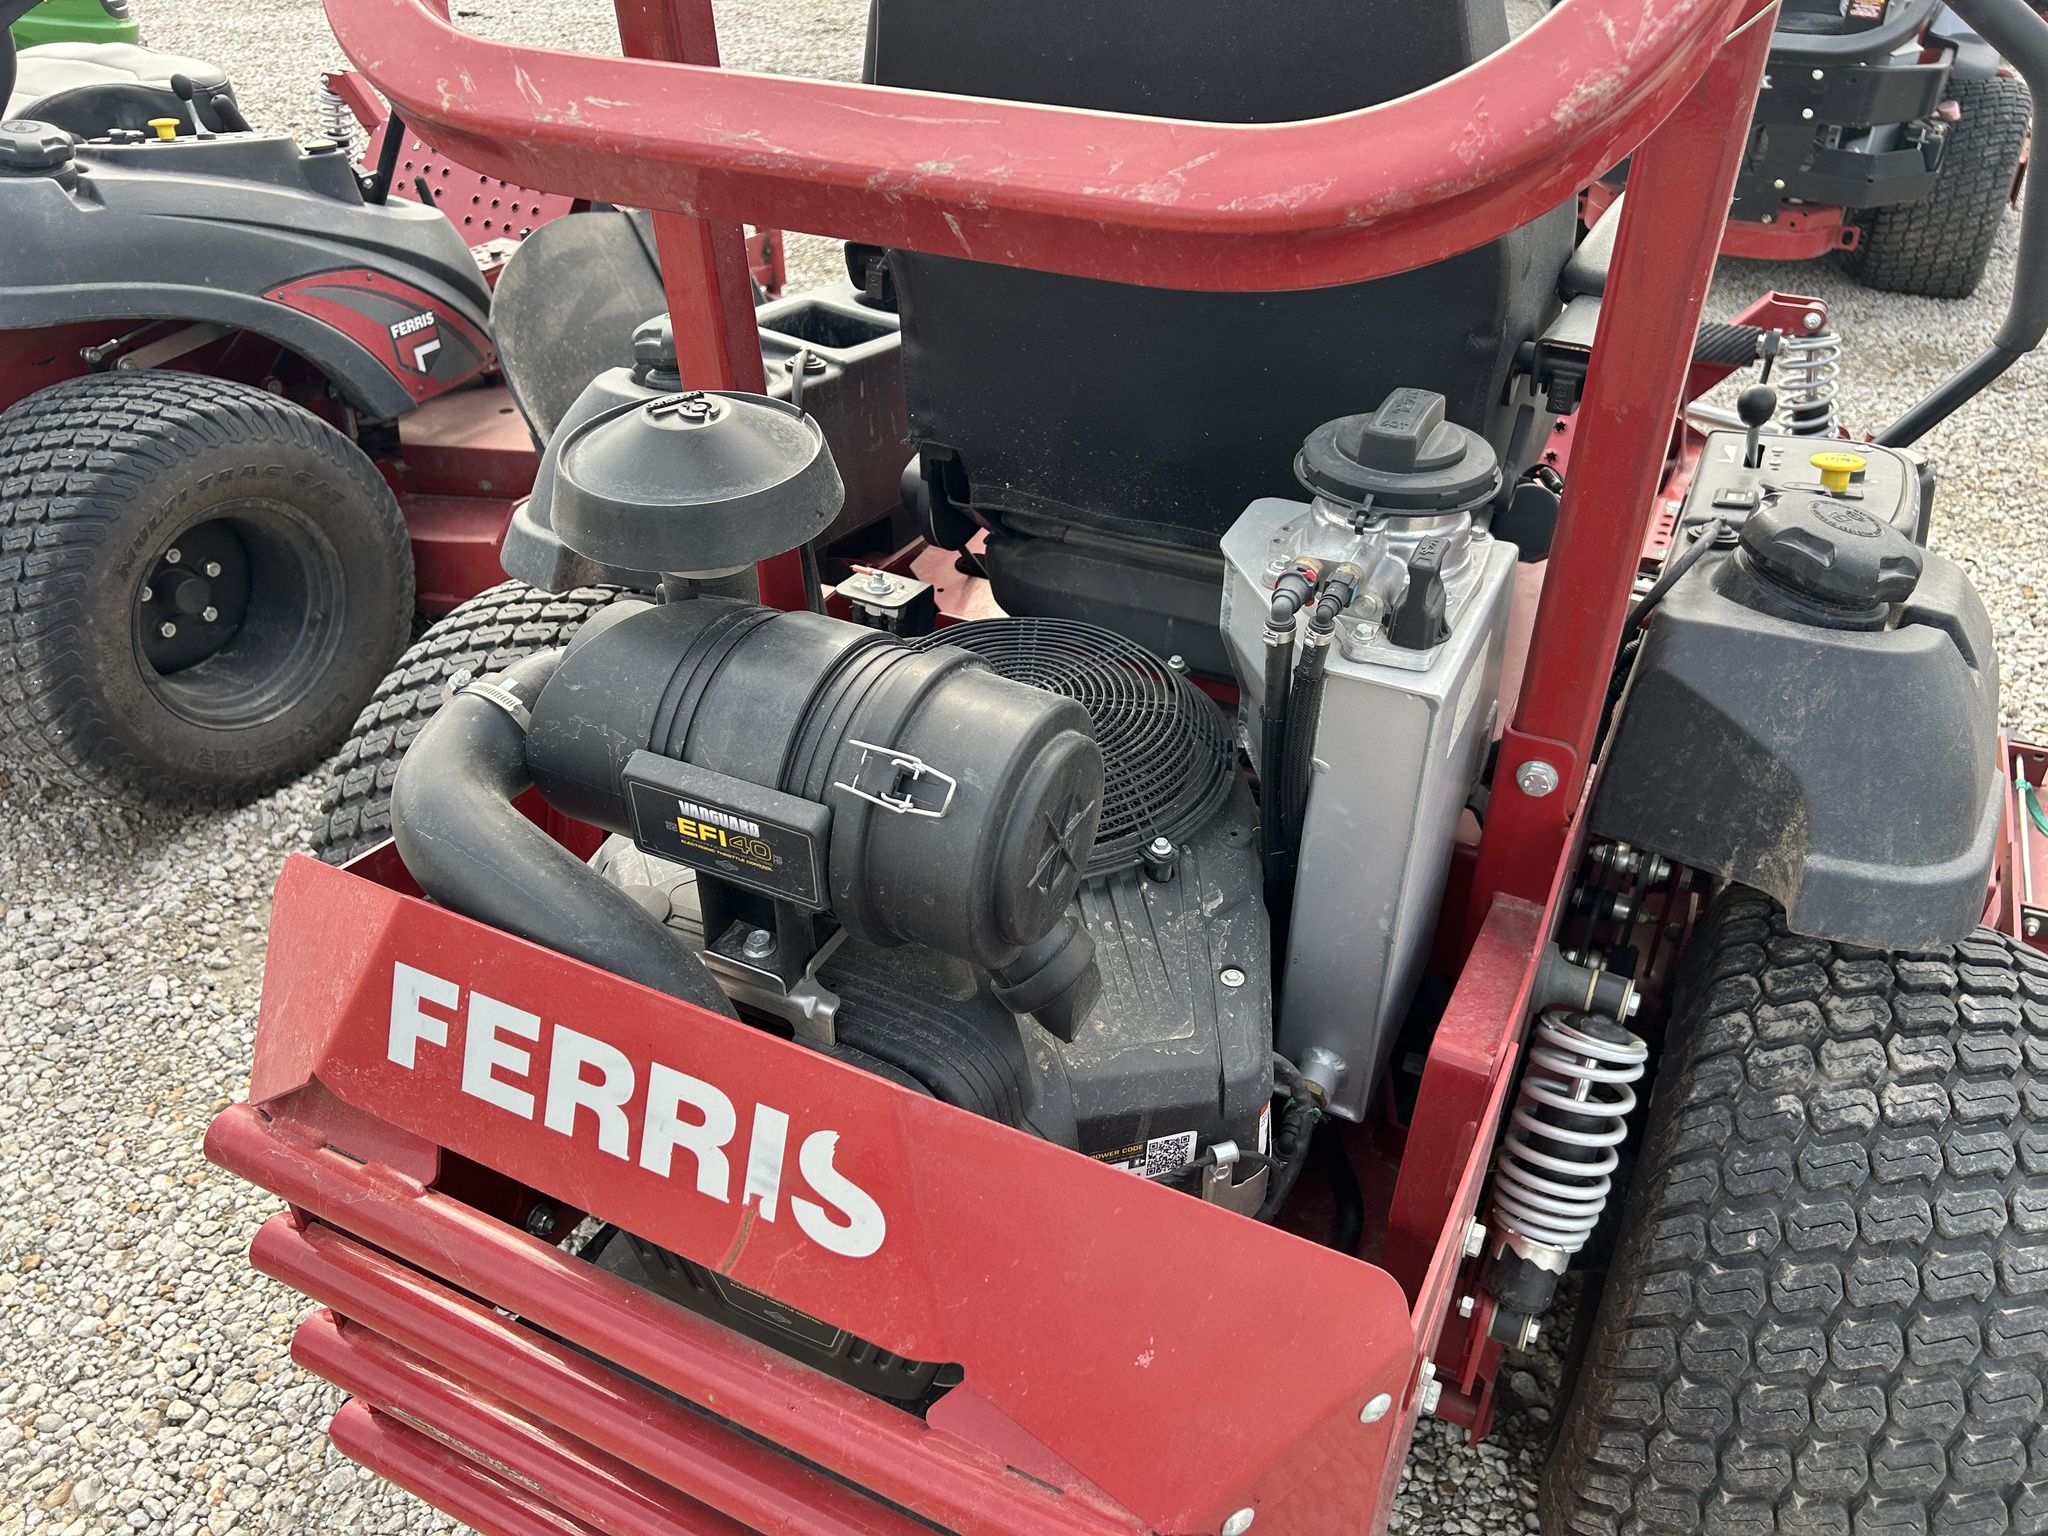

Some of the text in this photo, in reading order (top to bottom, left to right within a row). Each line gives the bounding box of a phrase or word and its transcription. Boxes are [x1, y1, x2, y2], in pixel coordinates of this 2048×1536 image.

[390, 311, 435, 339] FERRIS
[117, 488, 189, 581] MULTI
[196, 464, 286, 491] TRAC
[677, 799, 760, 838] VANGUARD
[387, 960, 887, 1259] FERRIS
[1121, 1144, 1144, 1154] CODE
